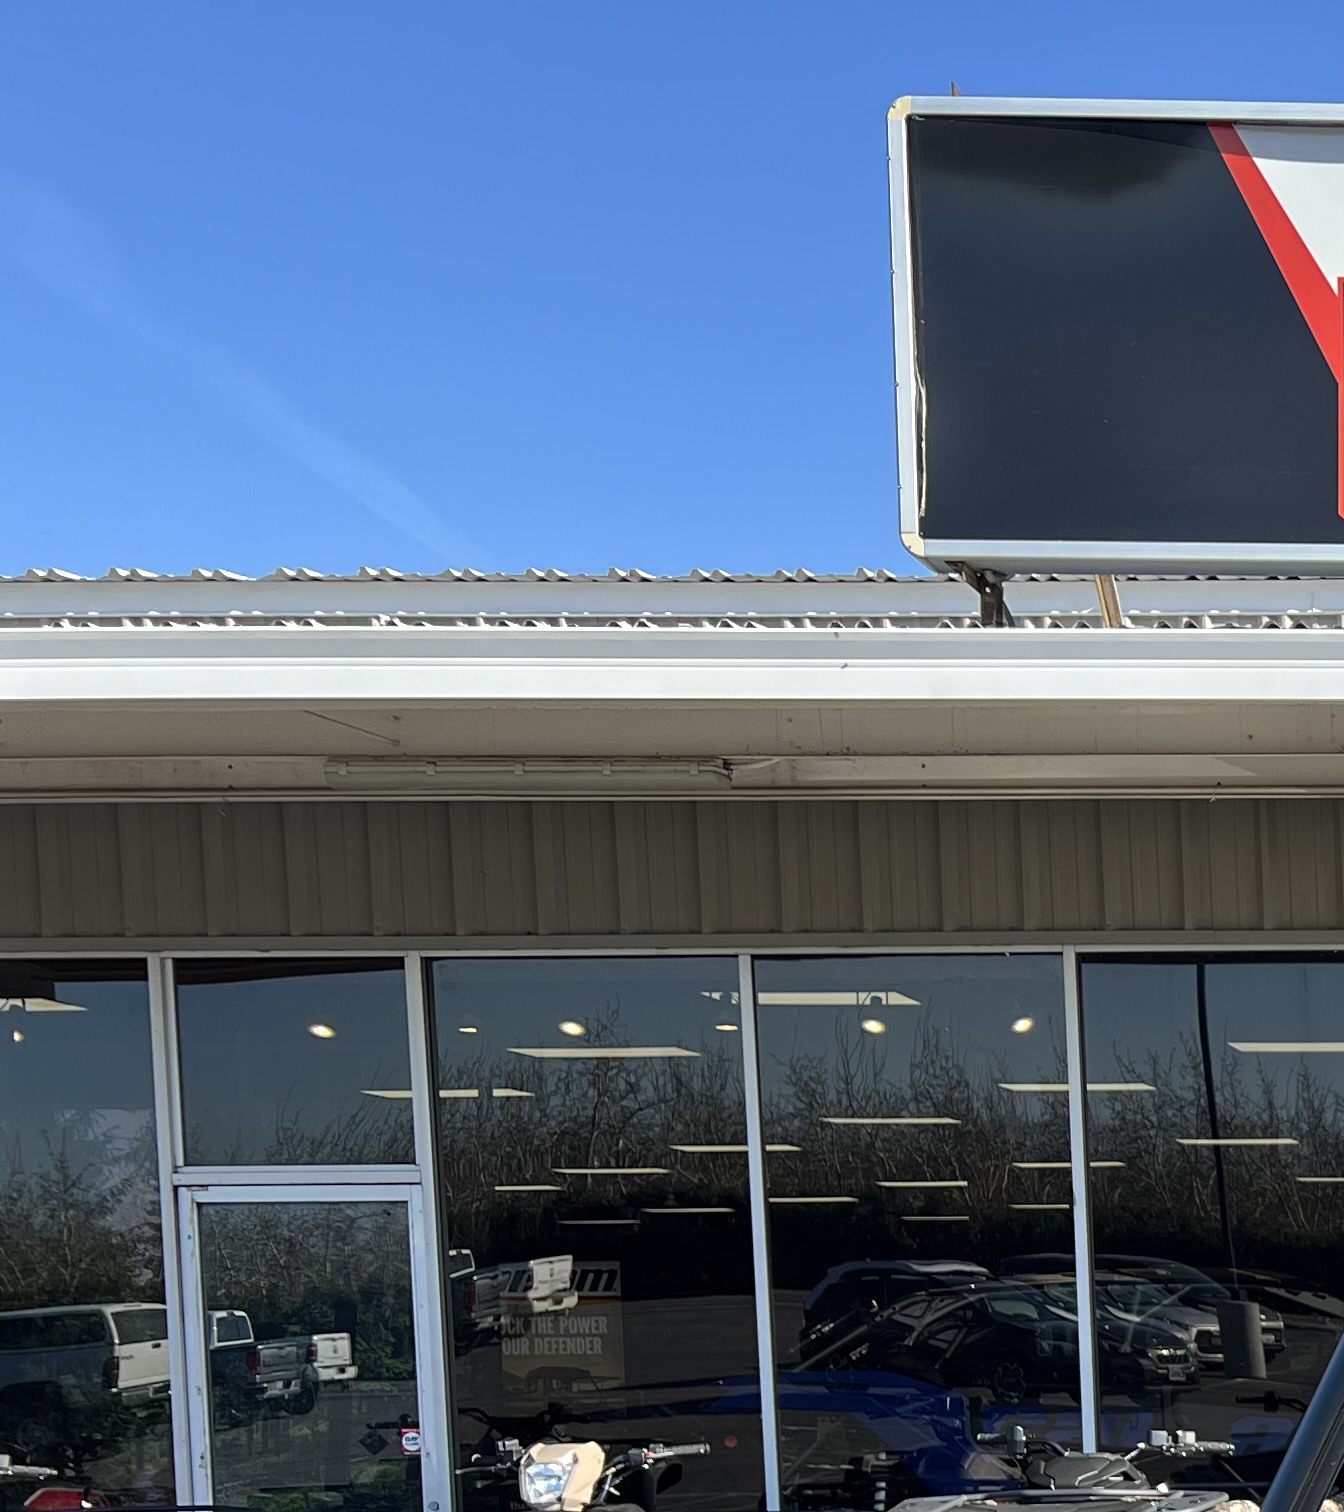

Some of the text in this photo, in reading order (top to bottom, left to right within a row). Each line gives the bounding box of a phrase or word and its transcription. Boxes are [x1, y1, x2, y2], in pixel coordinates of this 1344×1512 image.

[529, 1315, 556, 1335] THE
[559, 1315, 608, 1335] POWER
[534, 1337, 603, 1355] DEFENDER
